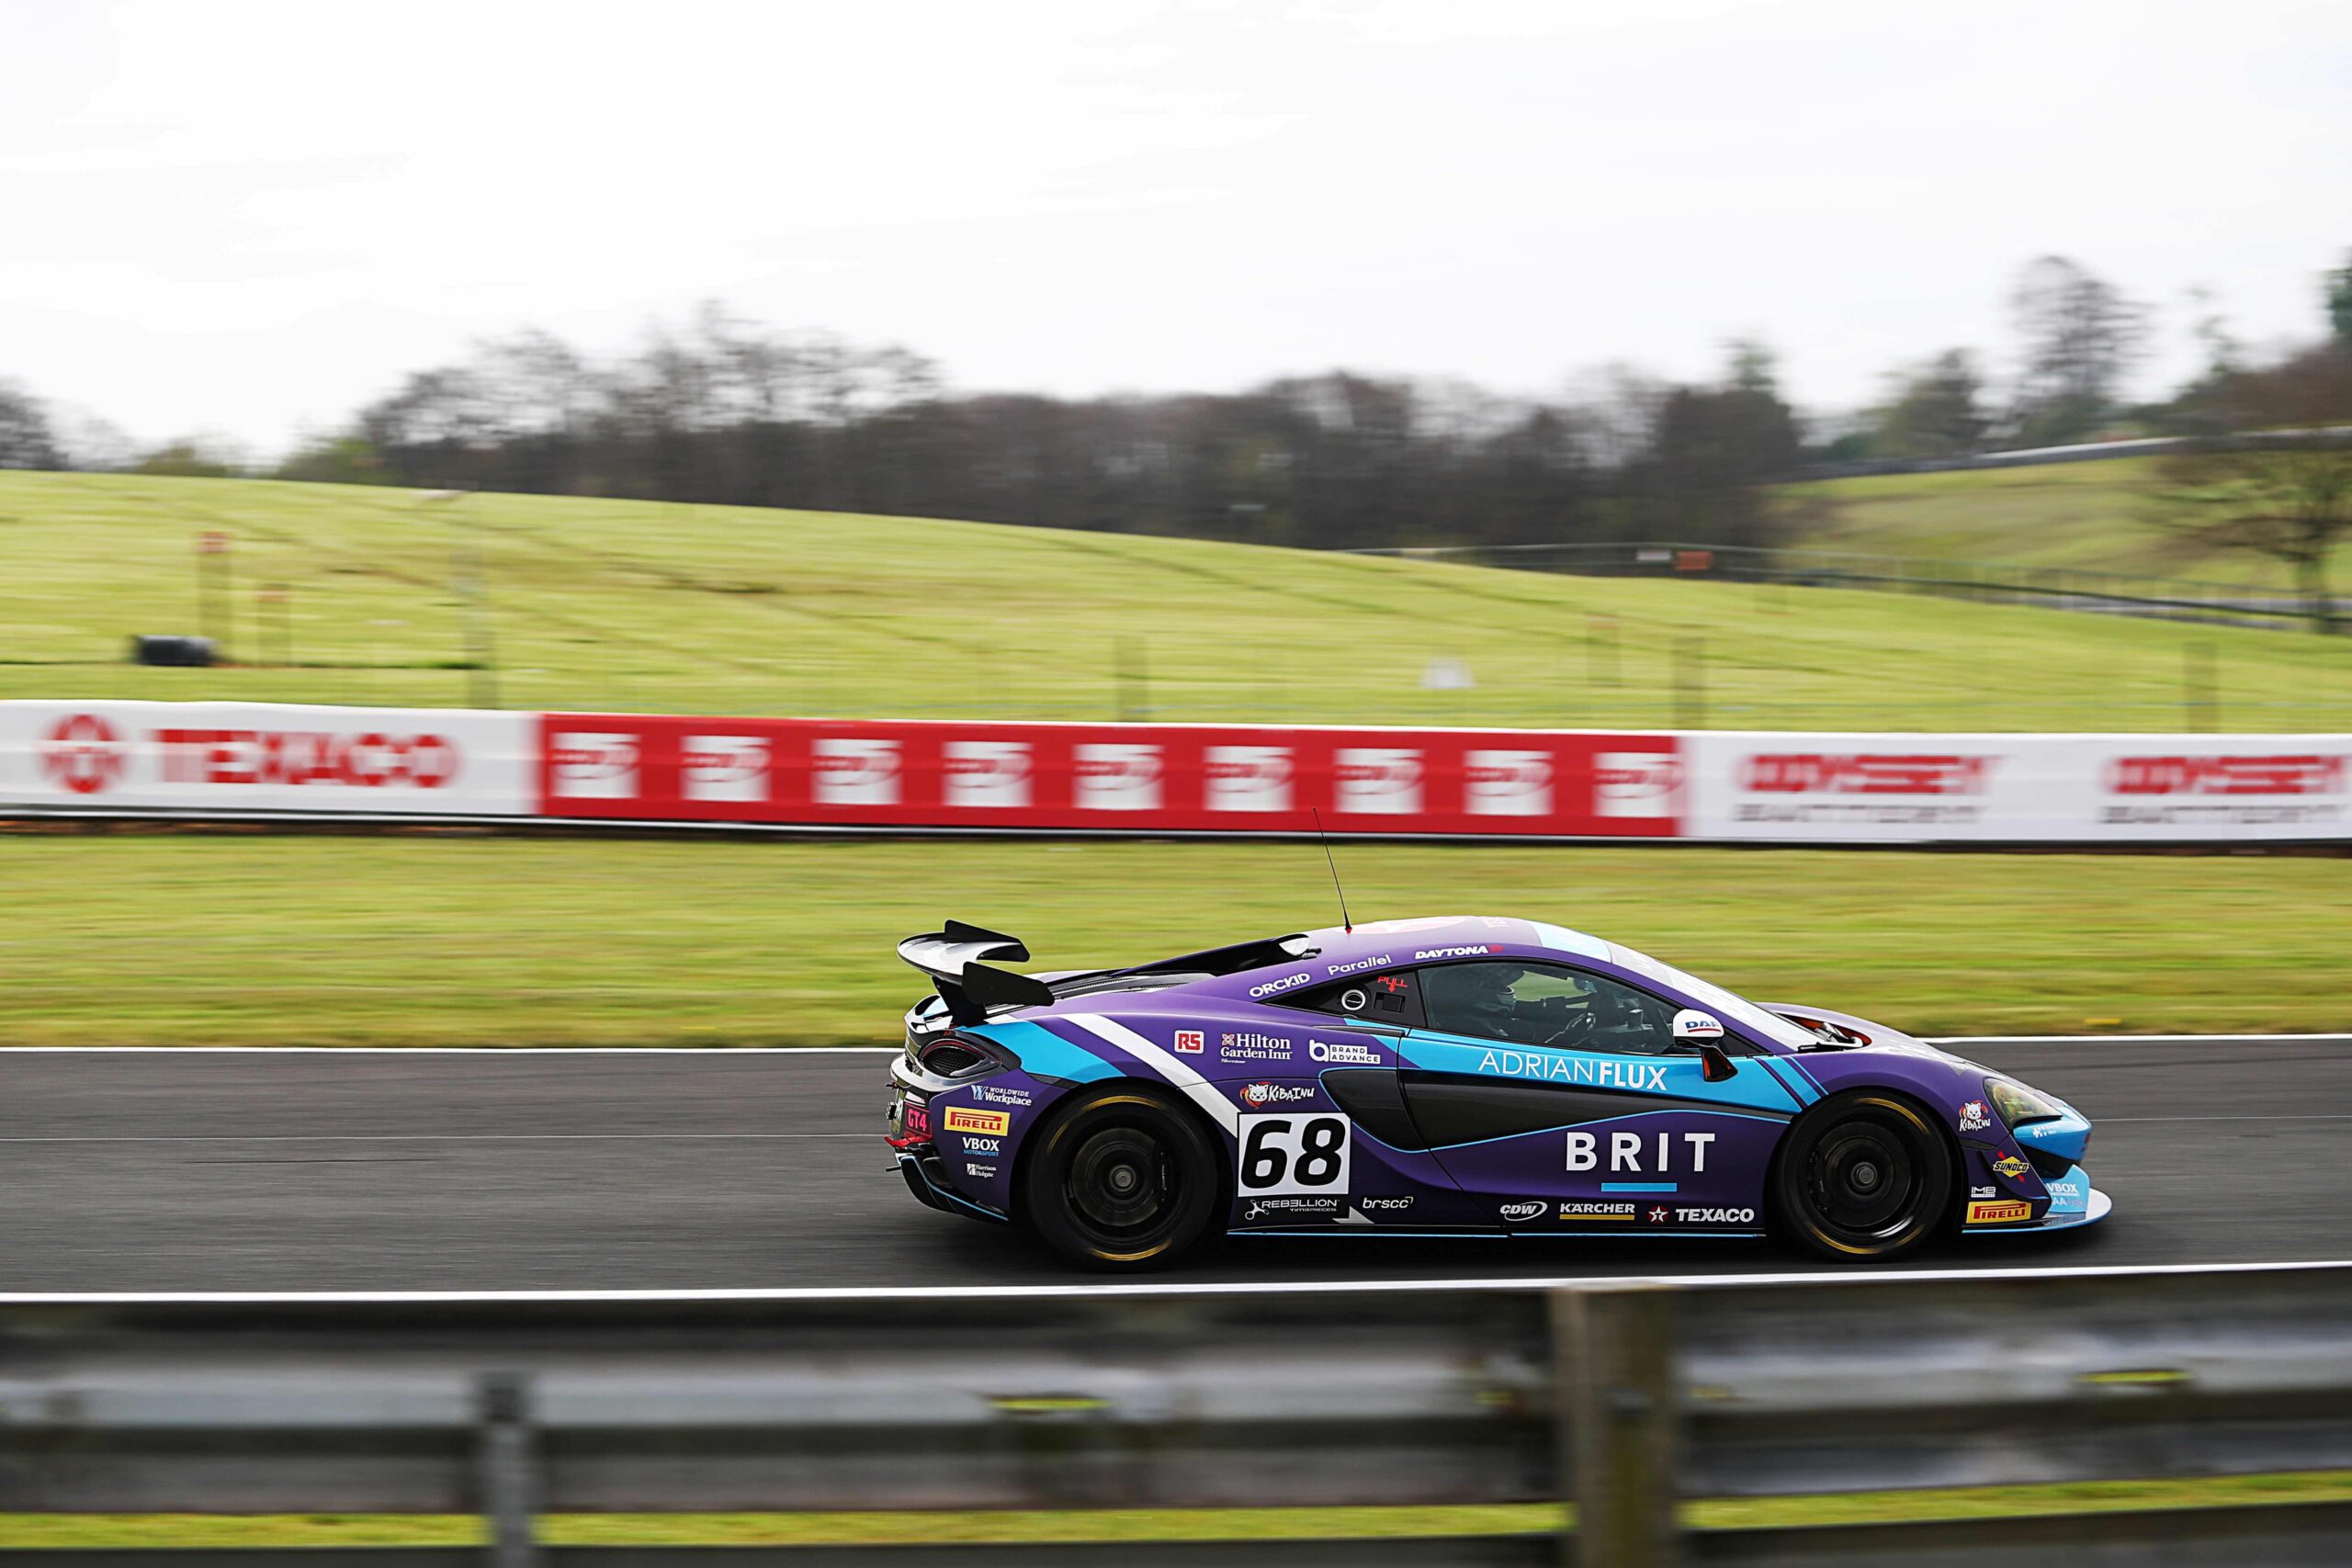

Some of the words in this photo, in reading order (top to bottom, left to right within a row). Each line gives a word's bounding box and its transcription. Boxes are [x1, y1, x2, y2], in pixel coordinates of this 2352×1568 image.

[1415, 945, 1488, 960] DAYTONA
[1328, 953, 1392, 976] Parallel
[1377, 976, 1408, 988] PULL
[1178, 1032, 1202, 1051] RS
[1237, 1033, 1291, 1050] Hilton
[1220, 1046, 1268, 1060] Garden
[1268, 1050, 1291, 1060] Inn
[1331, 1045, 1366, 1055] BRAND
[1330, 1054, 1380, 1063] ADVANCE
[985, 1091, 1032, 1106] Workplace
[989, 1087, 1030, 1098] WORLDWIDE
[908, 1108, 927, 1132] GT4
[950, 1111, 1002, 1131] PIRELLI
[962, 1137, 1000, 1152] VBOX
[1566, 1132, 1715, 1172] BRIT
[1240, 1118, 1346, 1190] 68
[1994, 1162, 2029, 1172] SUNOCO
[2045, 1182, 2078, 1193] VBOX
[1261, 1199, 1338, 1209] REBELLION
[1363, 1197, 1409, 1209] brscc
[1499, 1204, 1537, 1215] CDW
[1560, 1202, 1635, 1213] KÄRCHER
[1676, 1208, 1755, 1223] TEXACO
[1973, 1202, 2026, 1220] PIRELLI
